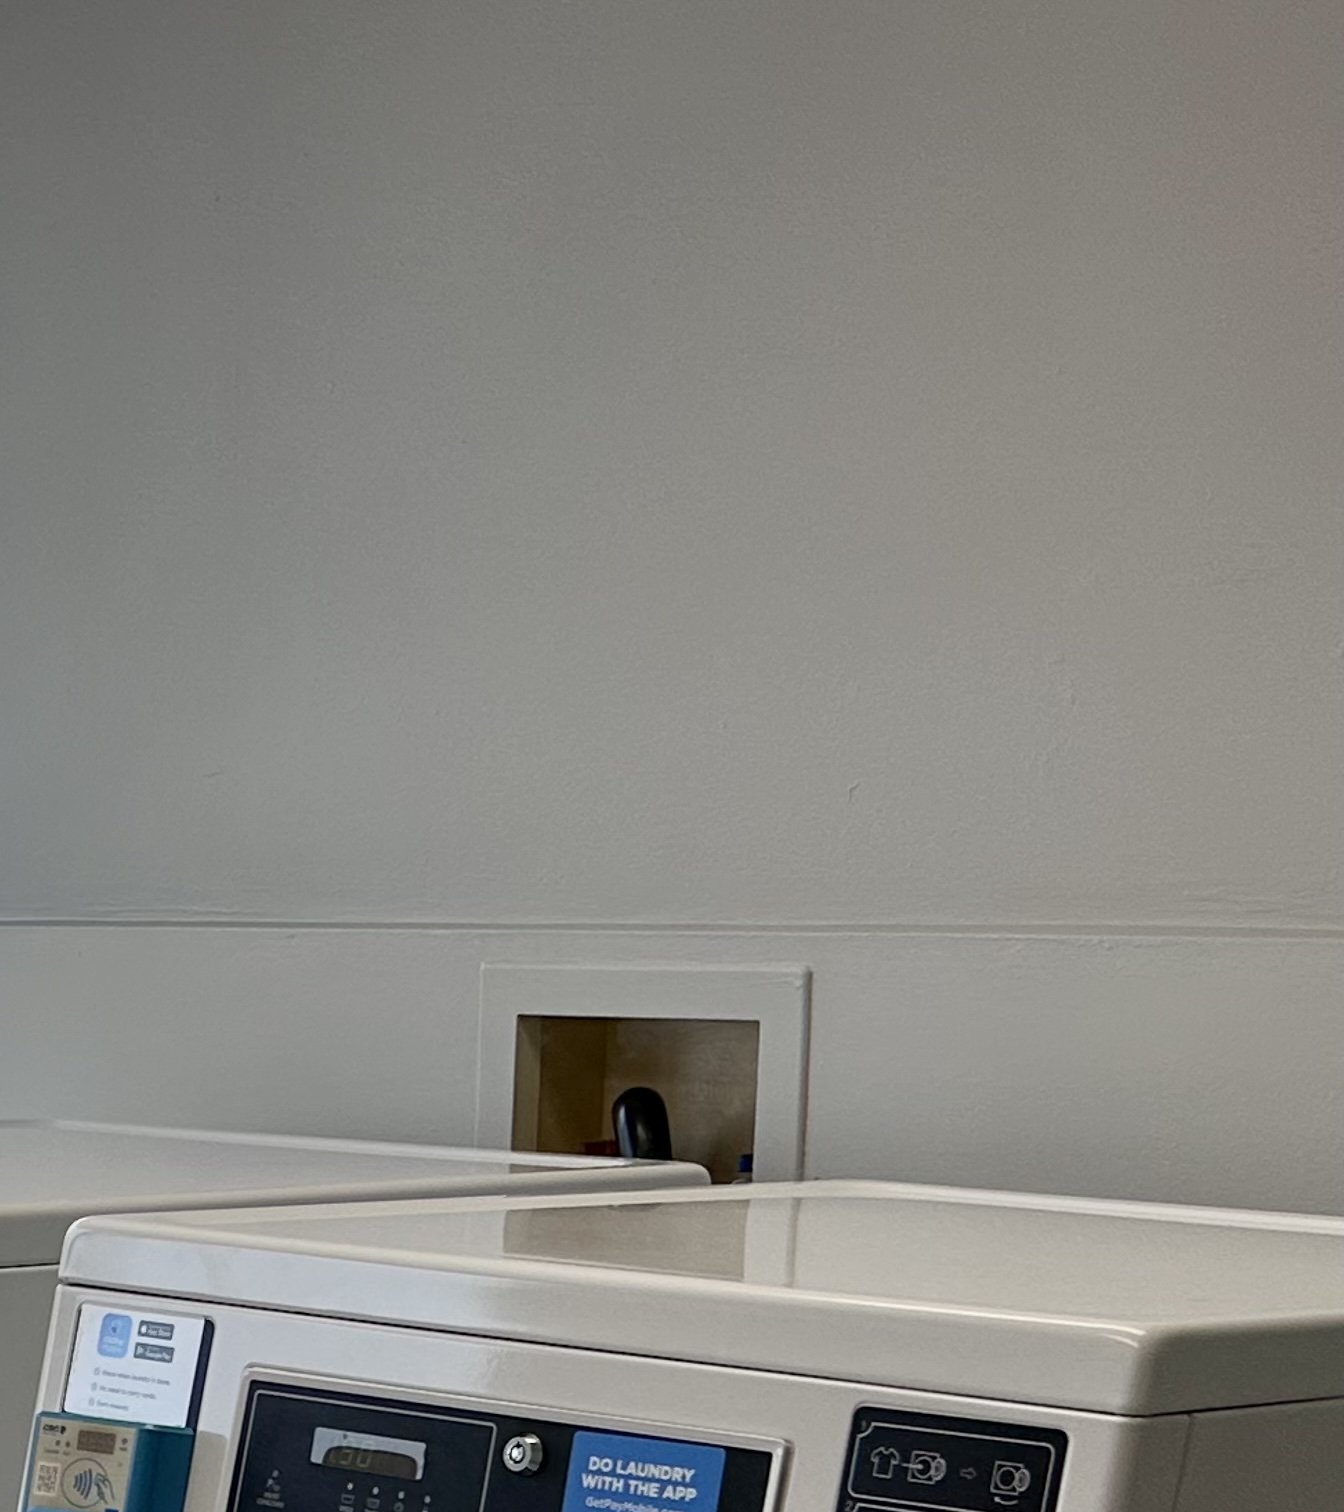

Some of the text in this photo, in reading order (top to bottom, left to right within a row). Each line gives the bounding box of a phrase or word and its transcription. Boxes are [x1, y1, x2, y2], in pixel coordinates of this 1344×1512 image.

[588, 1456, 695, 1483] DO LAUNDRY
[581, 1473, 697, 1502] WITH THE APP
